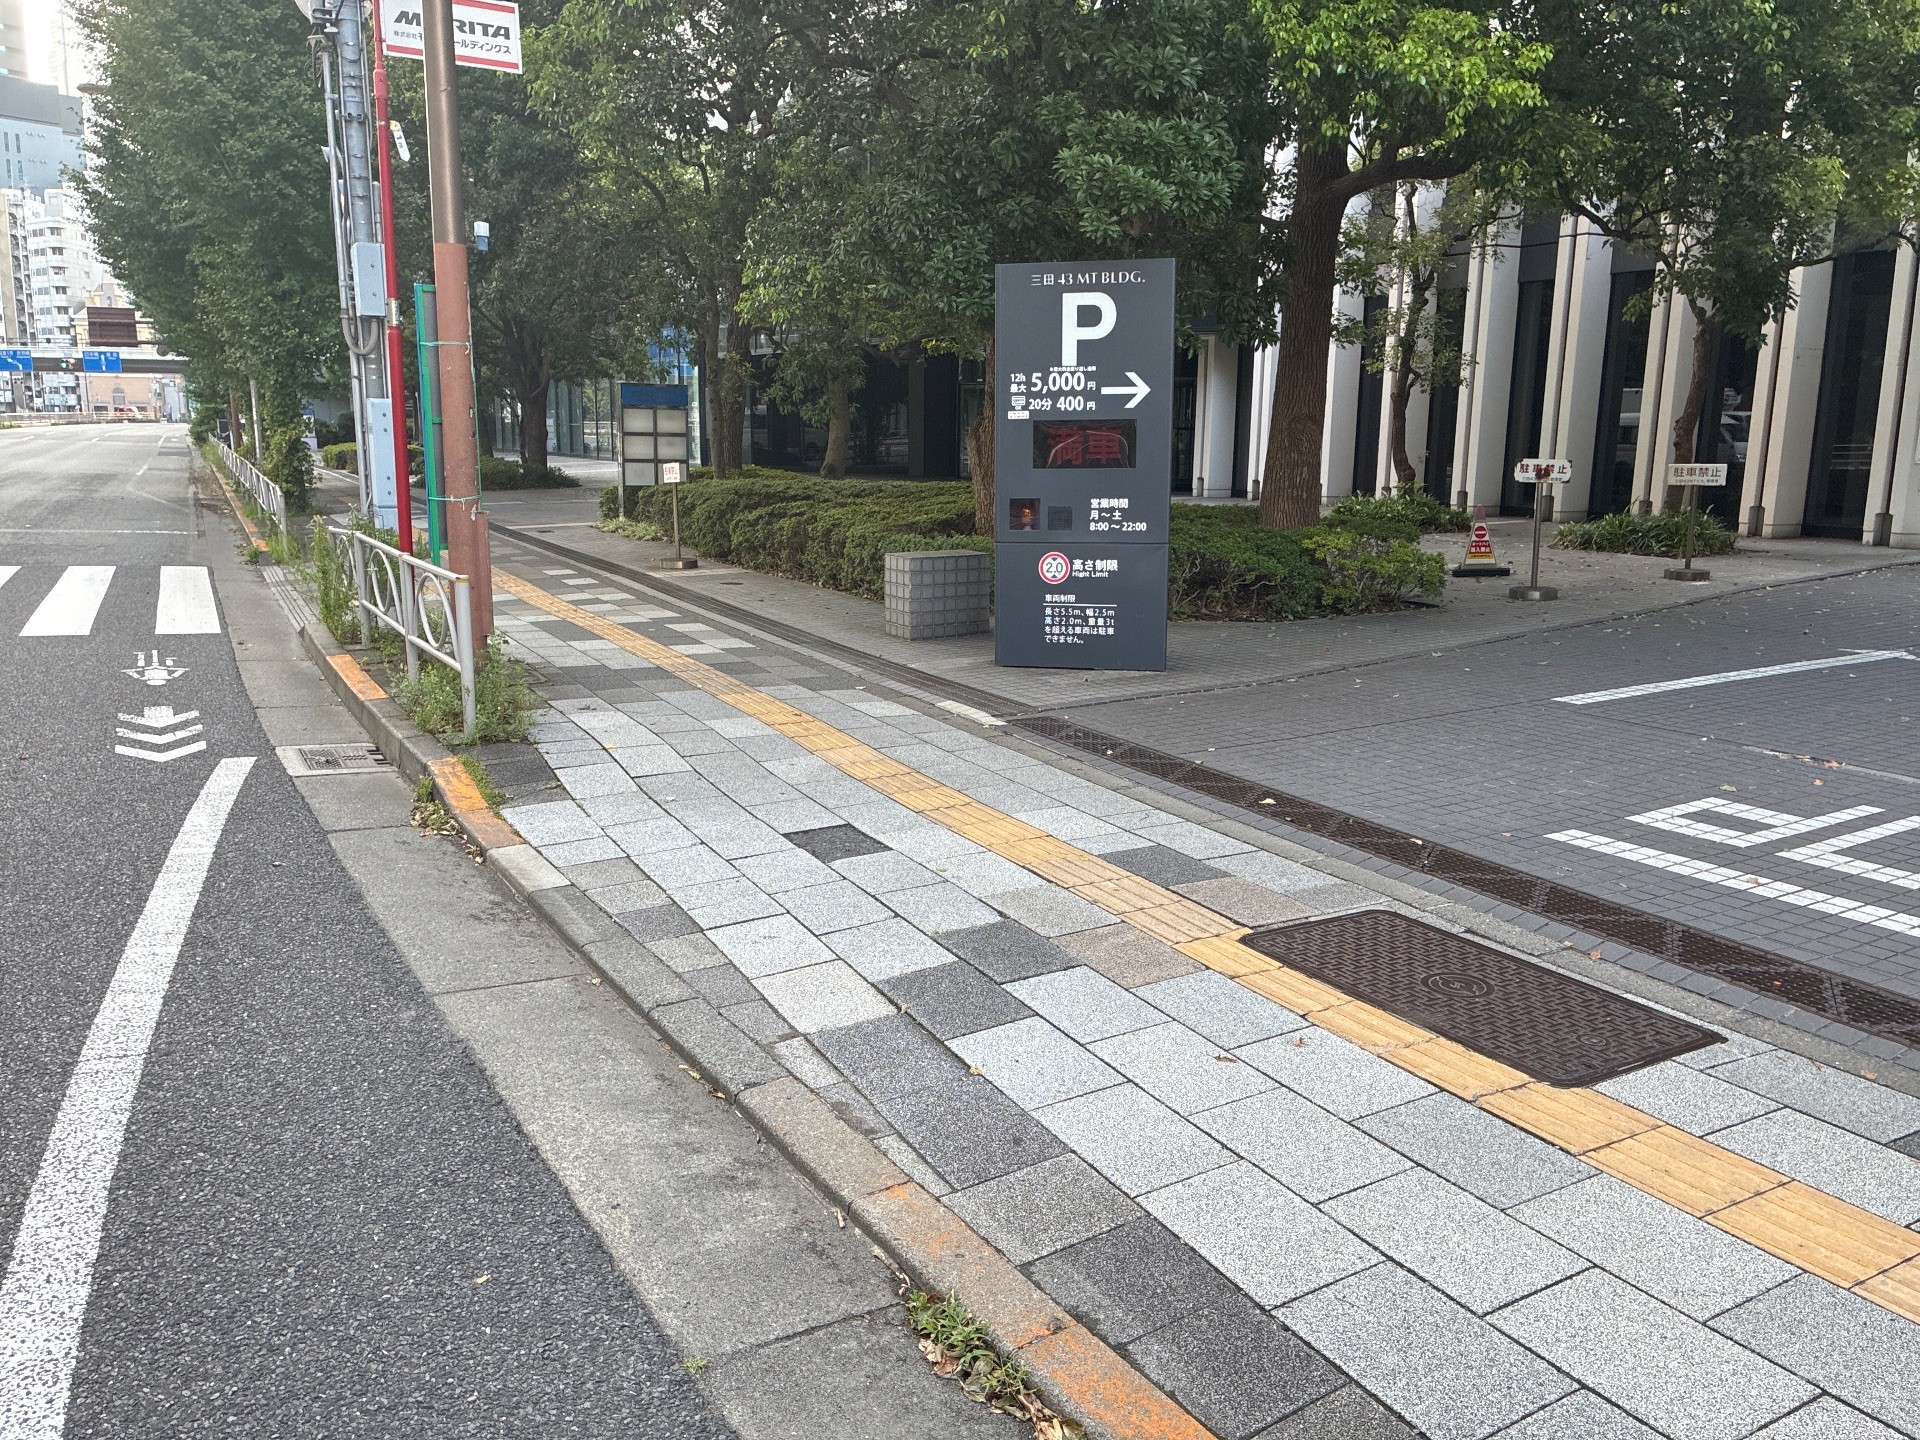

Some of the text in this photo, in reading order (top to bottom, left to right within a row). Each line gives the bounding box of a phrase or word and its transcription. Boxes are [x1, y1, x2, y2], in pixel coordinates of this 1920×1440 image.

[394, 10, 510, 40] MRITA
[1031, 270, 1146, 286] 三田 43 MT BLDG.
[1062, 292, 1117, 366] P
[1010, 373, 1026, 382] 12h
[1010, 384, 1026, 393] 最大
[1028, 398, 1052, 410] 20分
[1673, 466, 1722, 478] 駐車禁止
[1090, 498, 1129, 509] 営業時間
[1046, 562, 1063, 574] 2.0
[1072, 559, 1118, 572] 高さ制限
[1044, 594, 1076, 602] 車両制限
[1044, 626, 1115, 635] を超える車両は駐車
[1044, 636, 1084, 644] できません。
